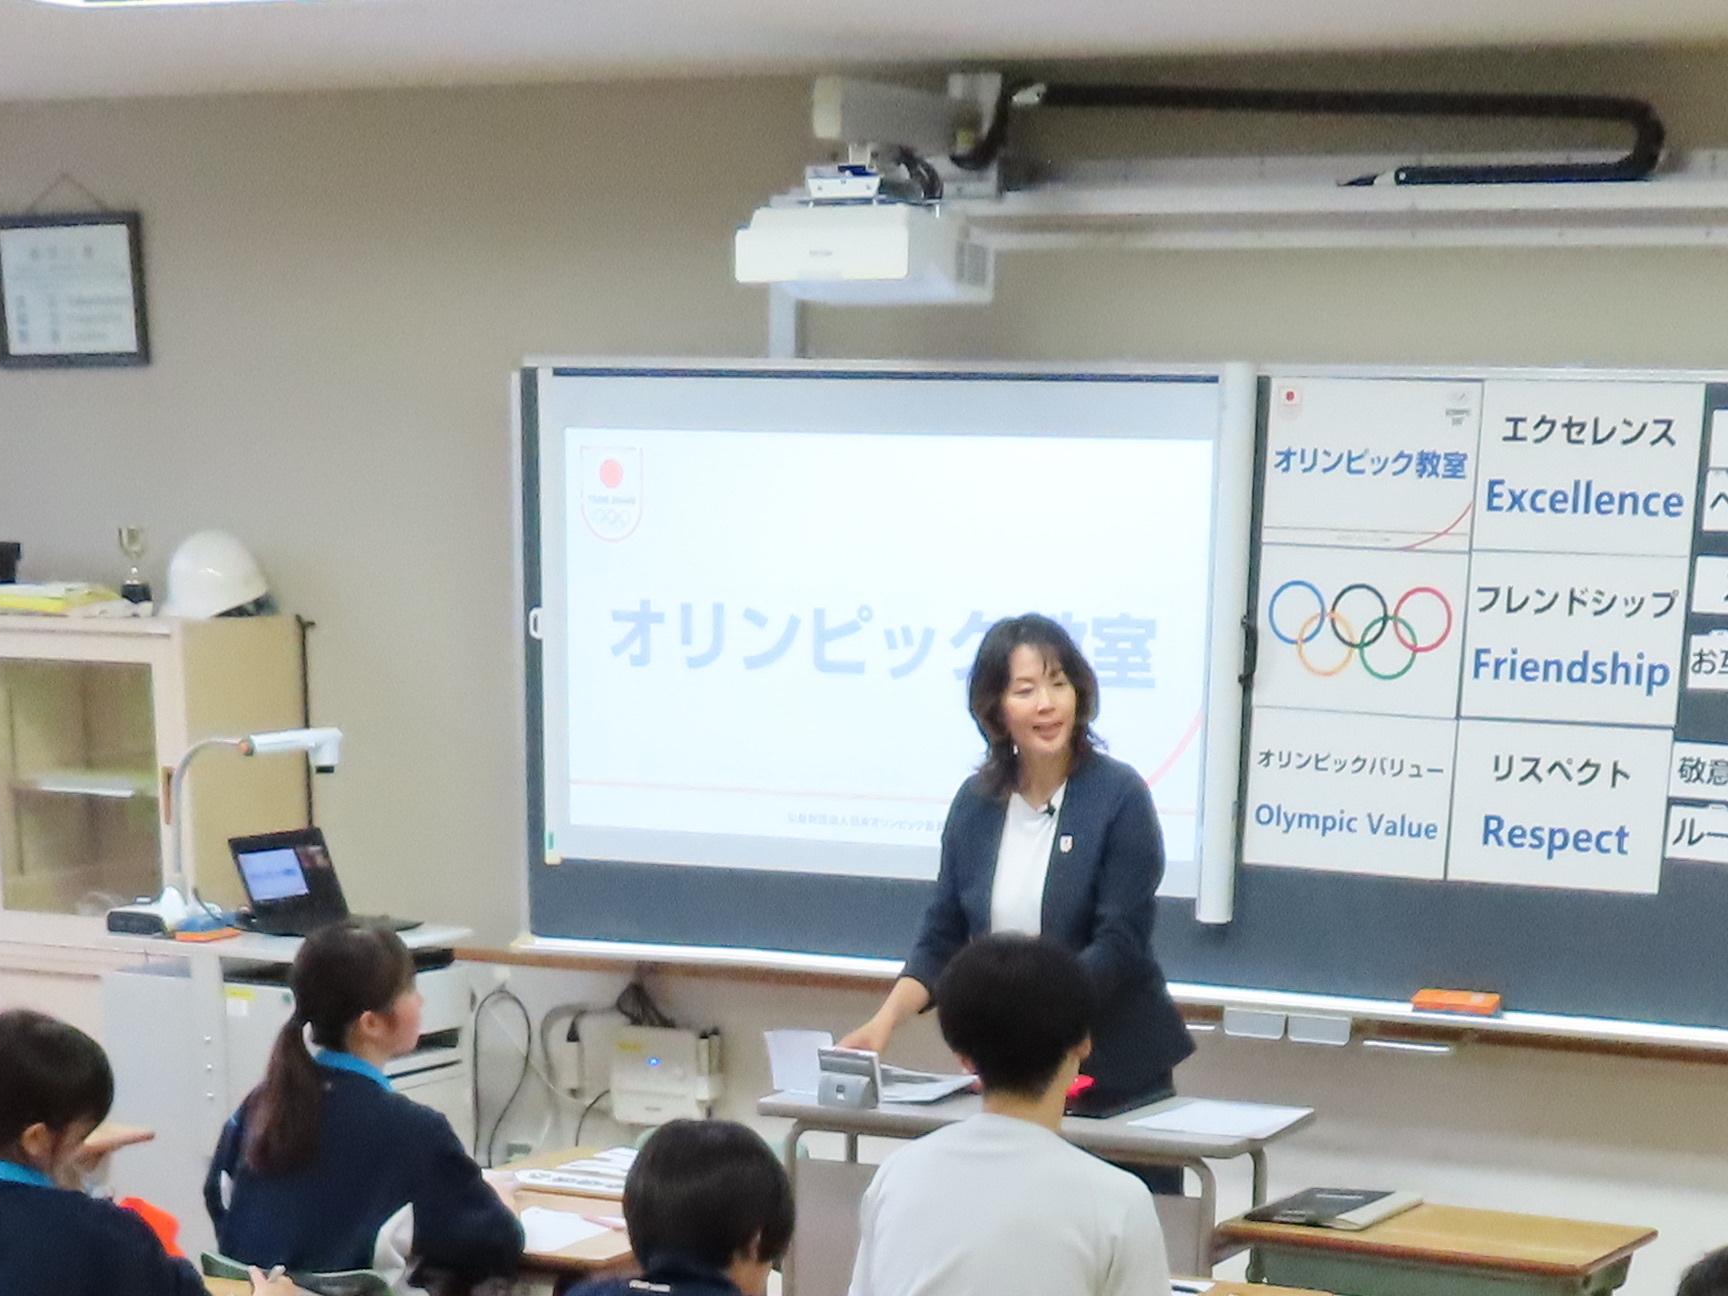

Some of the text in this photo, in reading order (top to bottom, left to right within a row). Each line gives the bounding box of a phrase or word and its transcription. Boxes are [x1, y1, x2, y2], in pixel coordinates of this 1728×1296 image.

[1502, 415, 1676, 446] エクセレンス
[1274, 447, 1469, 479] オリンピック教室
[1486, 479, 1684, 517] Excellence
[1477, 586, 1679, 618] フレンドシップ
[610, 598, 1157, 690] オリンピッ室
[1472, 648, 1670, 696] Friendship
[1258, 750, 1444, 778] オリンピックバリュー
[1492, 754, 1631, 789] リスペクト
[1255, 804, 1438, 840] Olympic Value
[1482, 814, 1630, 859] Respect
